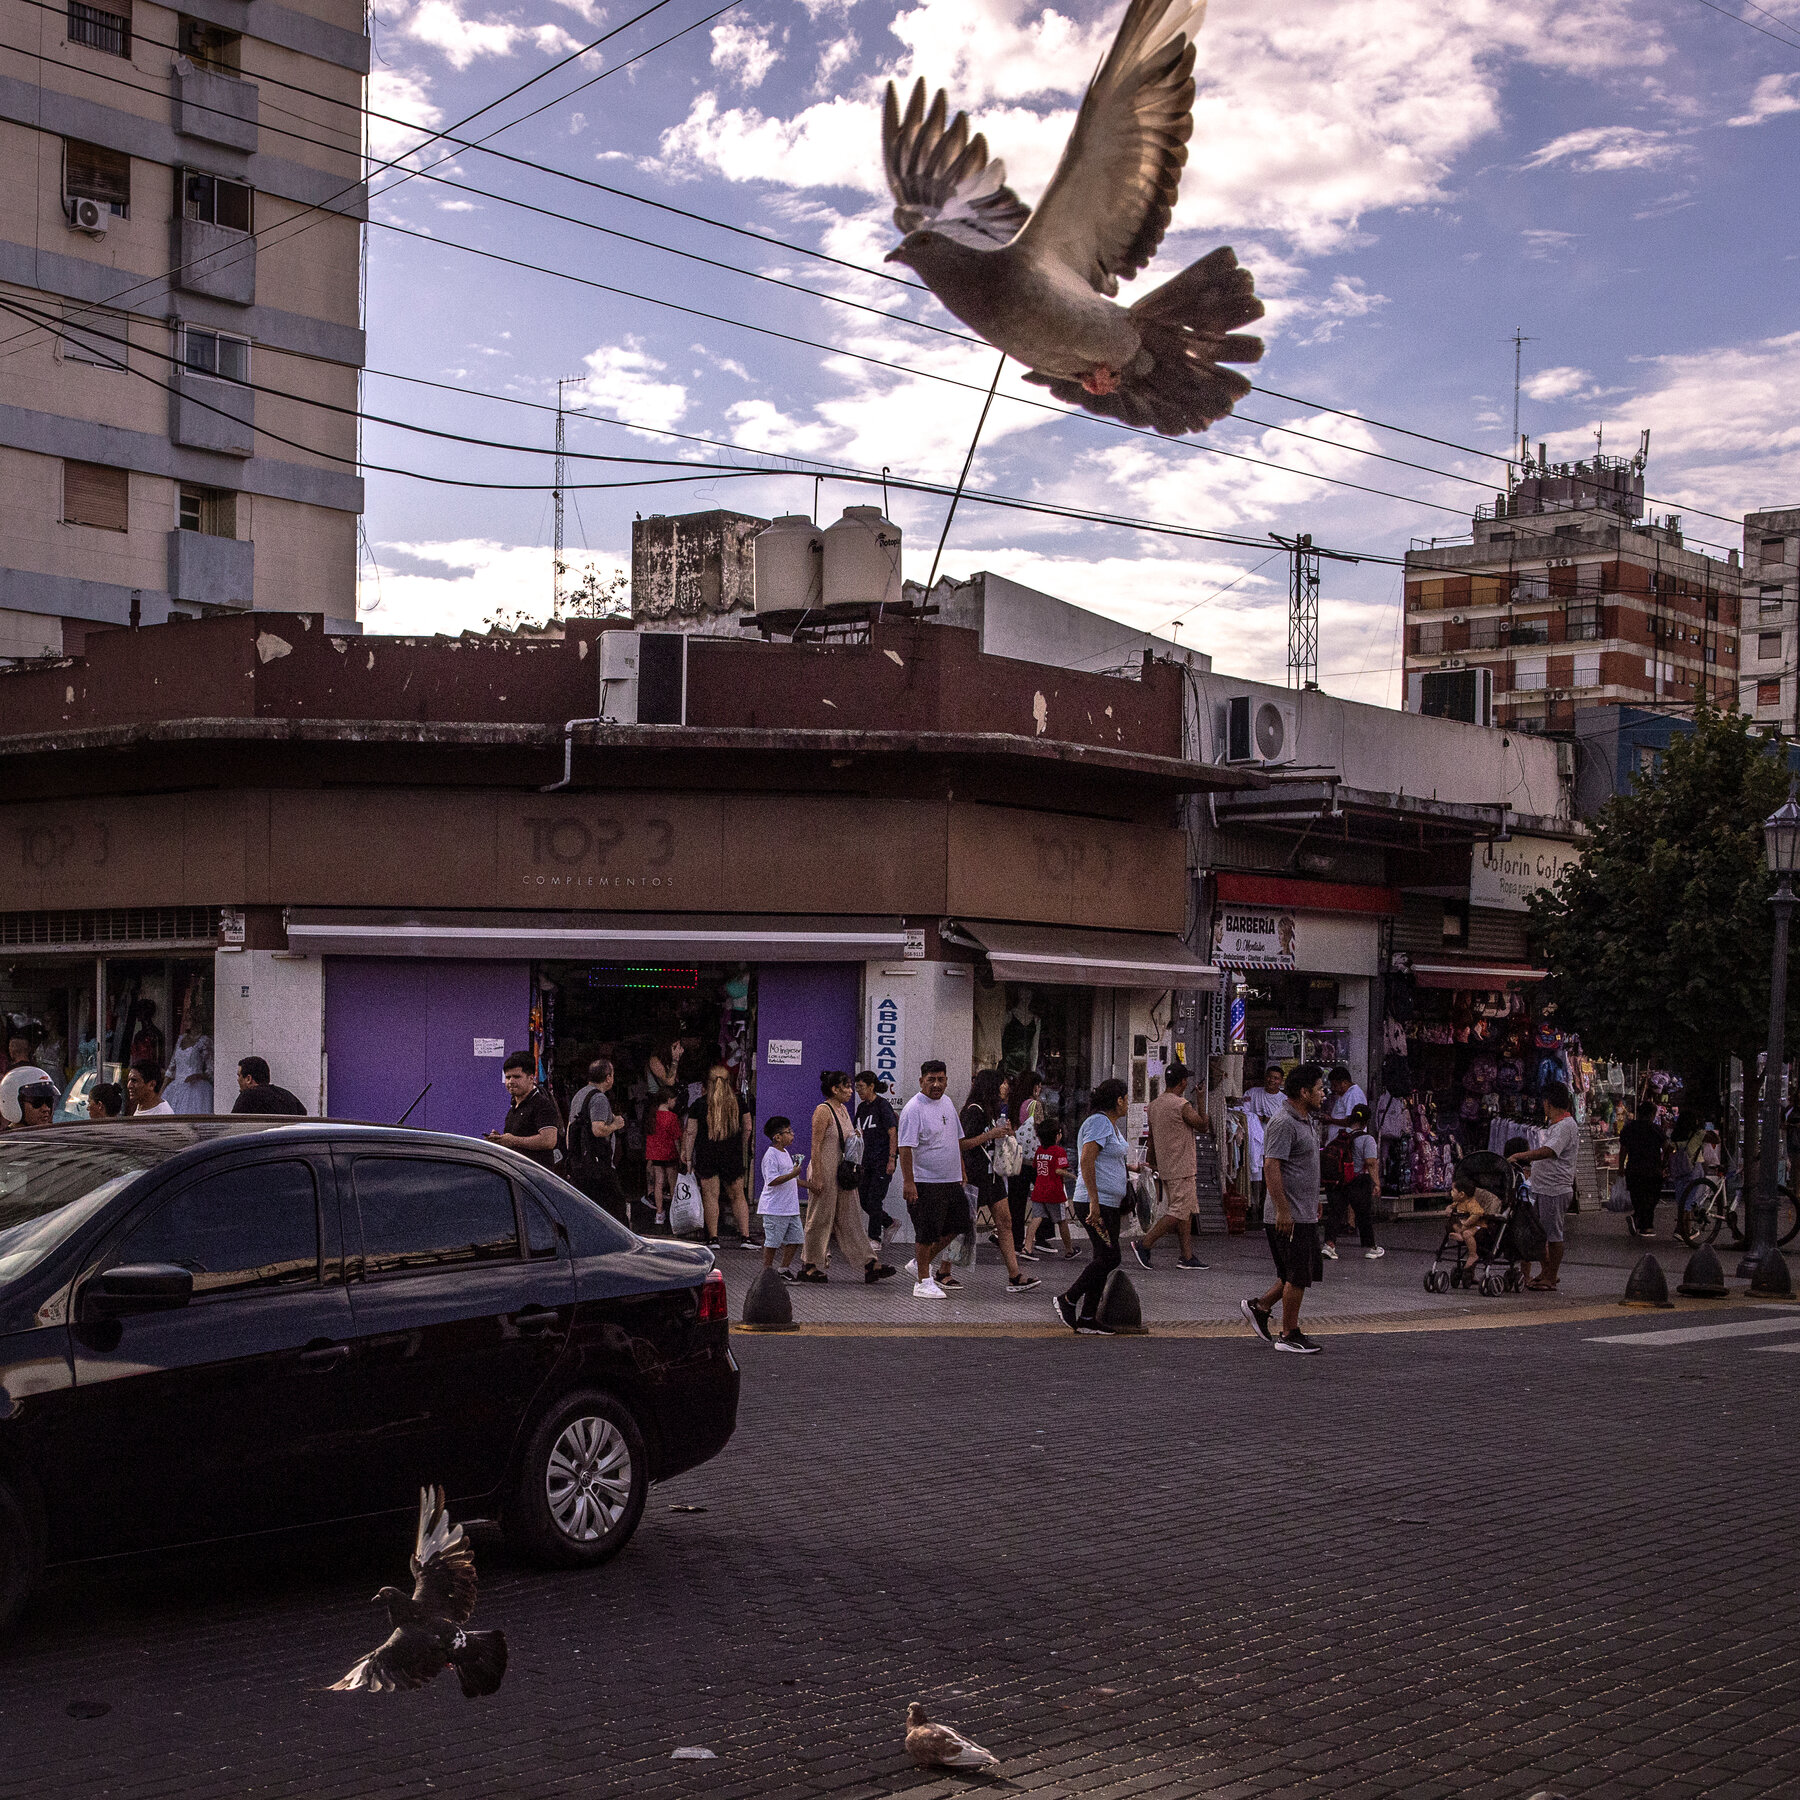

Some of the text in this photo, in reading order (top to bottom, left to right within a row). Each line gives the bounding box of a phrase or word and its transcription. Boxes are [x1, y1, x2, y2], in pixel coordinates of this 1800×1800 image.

[522, 817, 674, 866] TOP 3
[521, 874, 674, 887] COMPLEMENTOS
[1226, 915, 1275, 934] BARBERÍA
[769, 1043, 779, 1054] No
[876, 999, 898, 1082] ABOGADA
